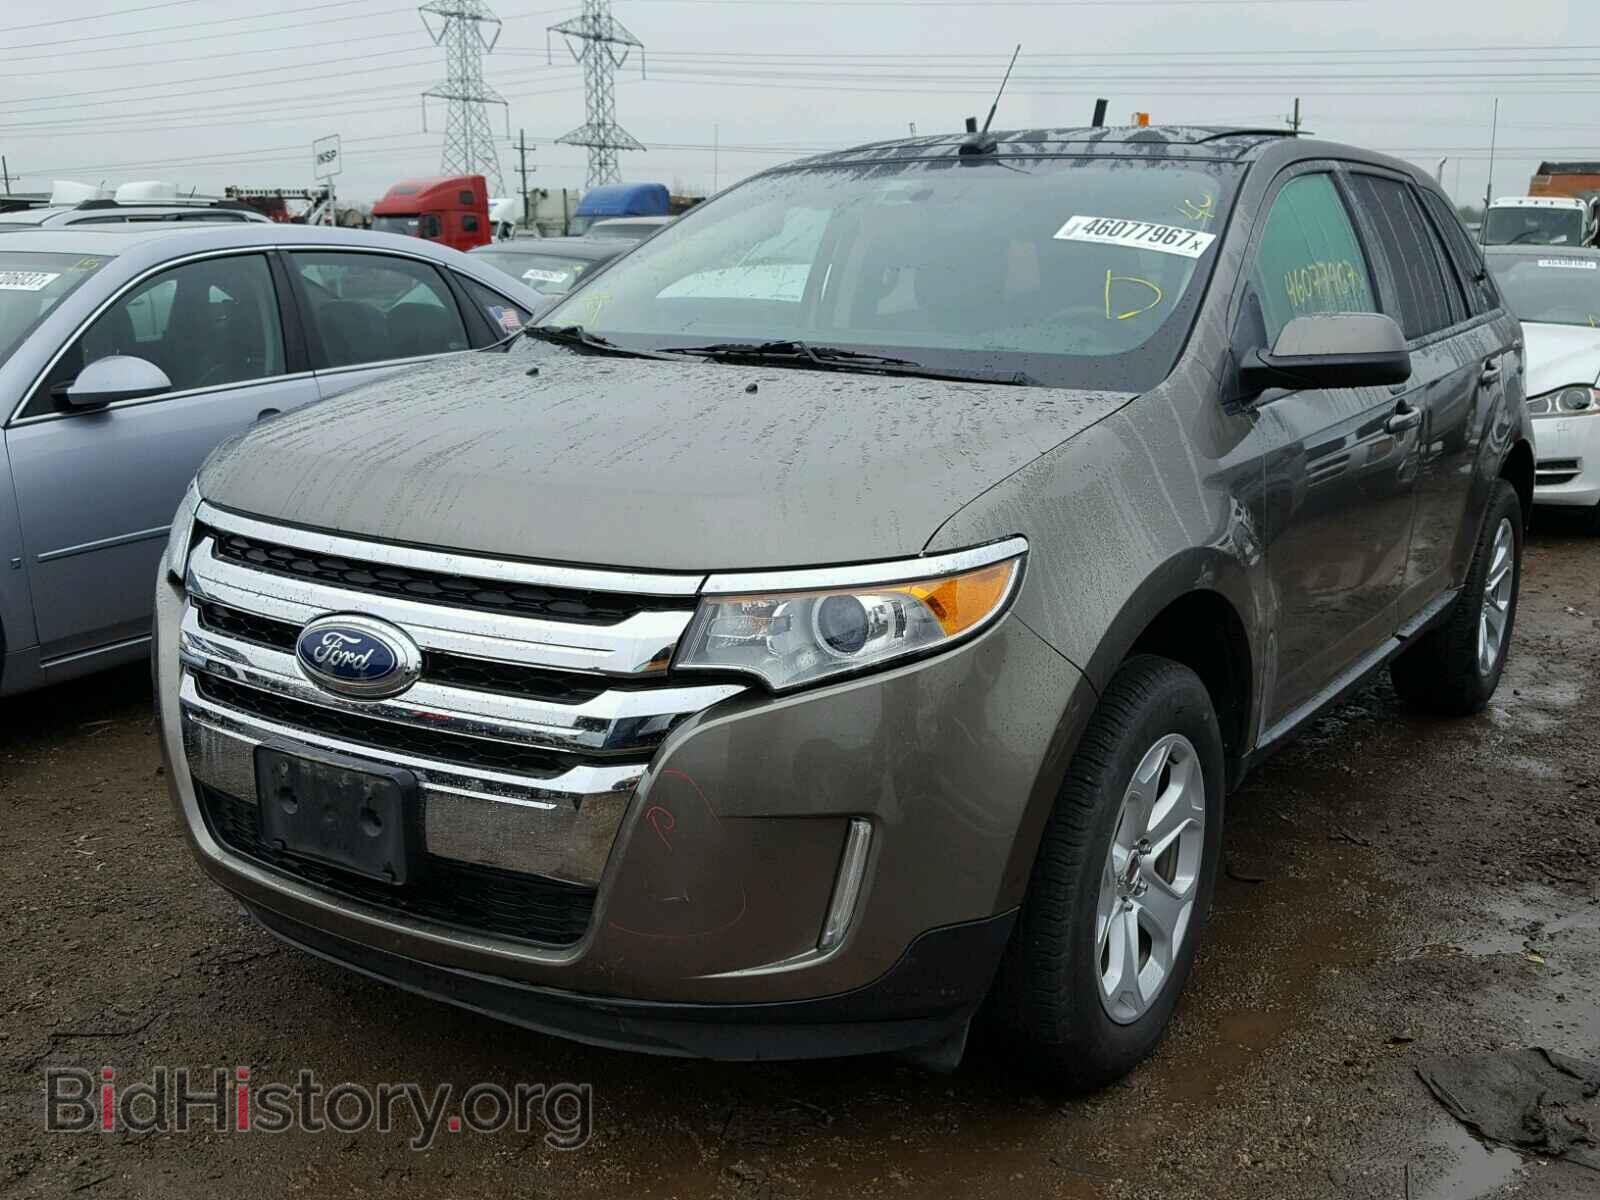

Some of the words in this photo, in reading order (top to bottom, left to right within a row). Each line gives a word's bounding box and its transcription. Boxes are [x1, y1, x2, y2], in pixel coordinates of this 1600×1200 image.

[317, 149, 337, 166] INSP
[1104, 268, 1163, 320] D
[314, 631, 375, 671] Ford
